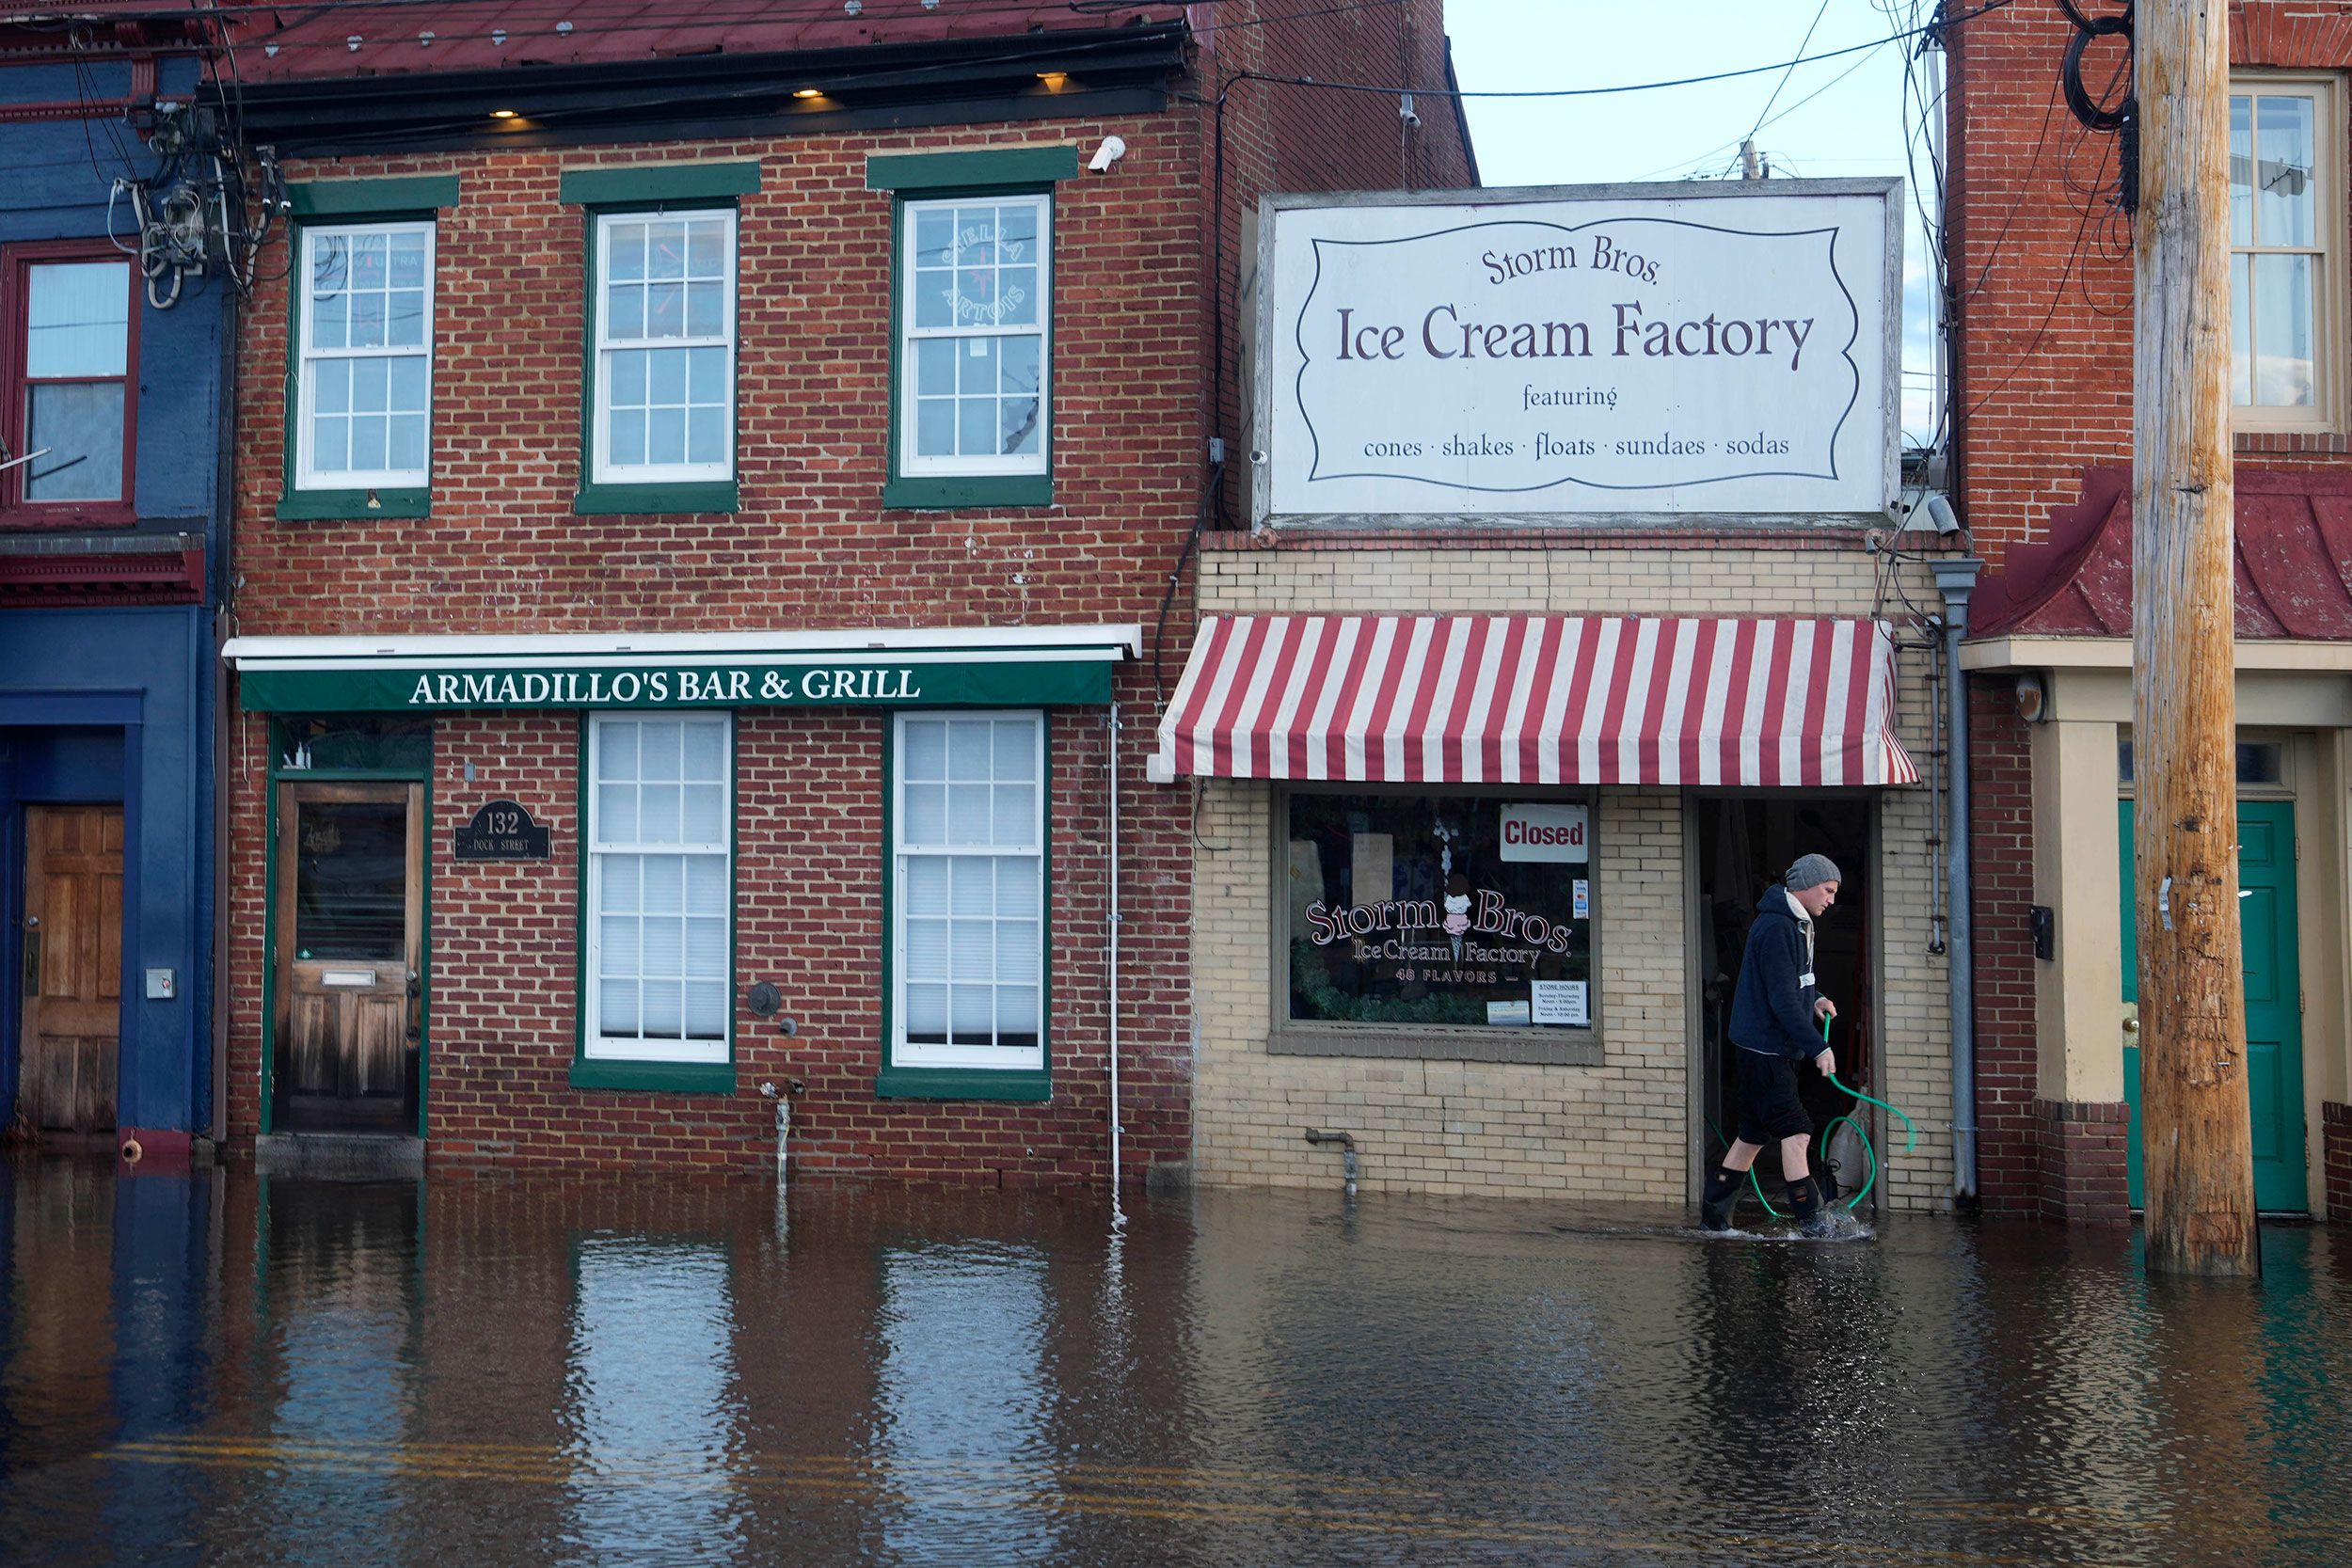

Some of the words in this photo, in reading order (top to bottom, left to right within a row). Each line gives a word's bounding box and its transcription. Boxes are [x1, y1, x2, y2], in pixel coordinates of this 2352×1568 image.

[376, 256, 419, 267] UTRA
[1482, 245, 1578, 285] Storm
[1590, 235, 1661, 286] Bros.
[942, 285, 1025, 322] ARTOIS
[1336, 309, 1405, 360] Ice
[1422, 303, 1594, 359] Cream
[1612, 300, 1815, 372] Factory
[1523, 384, 1618, 411] featuring
[1364, 442, 1422, 457] cones
[1442, 433, 1514, 456] shakes
[1534, 432, 1596, 461] floats
[1615, 431, 1705, 456] sundaes
[1725, 431, 1789, 454] sodas
[408, 672, 668, 704] ARMADILLO'S
[676, 671, 753, 701] BAR
[760, 671, 793, 700] &
[801, 670, 921, 699] GRILL
[487, 812, 519, 834] 132
[1505, 820, 1583, 846] Closed
[473, 838, 495, 851] DOCK
[501, 838, 530, 852] STREET
[1305, 898, 1440, 945] Storm
[1472, 889, 1572, 958] Bros.
[1353, 939, 1381, 960] Ice
[1383, 939, 1450, 961] Cream
[1465, 942, 1540, 969] Factory
[1422, 969, 1497, 984] FLAVORS
